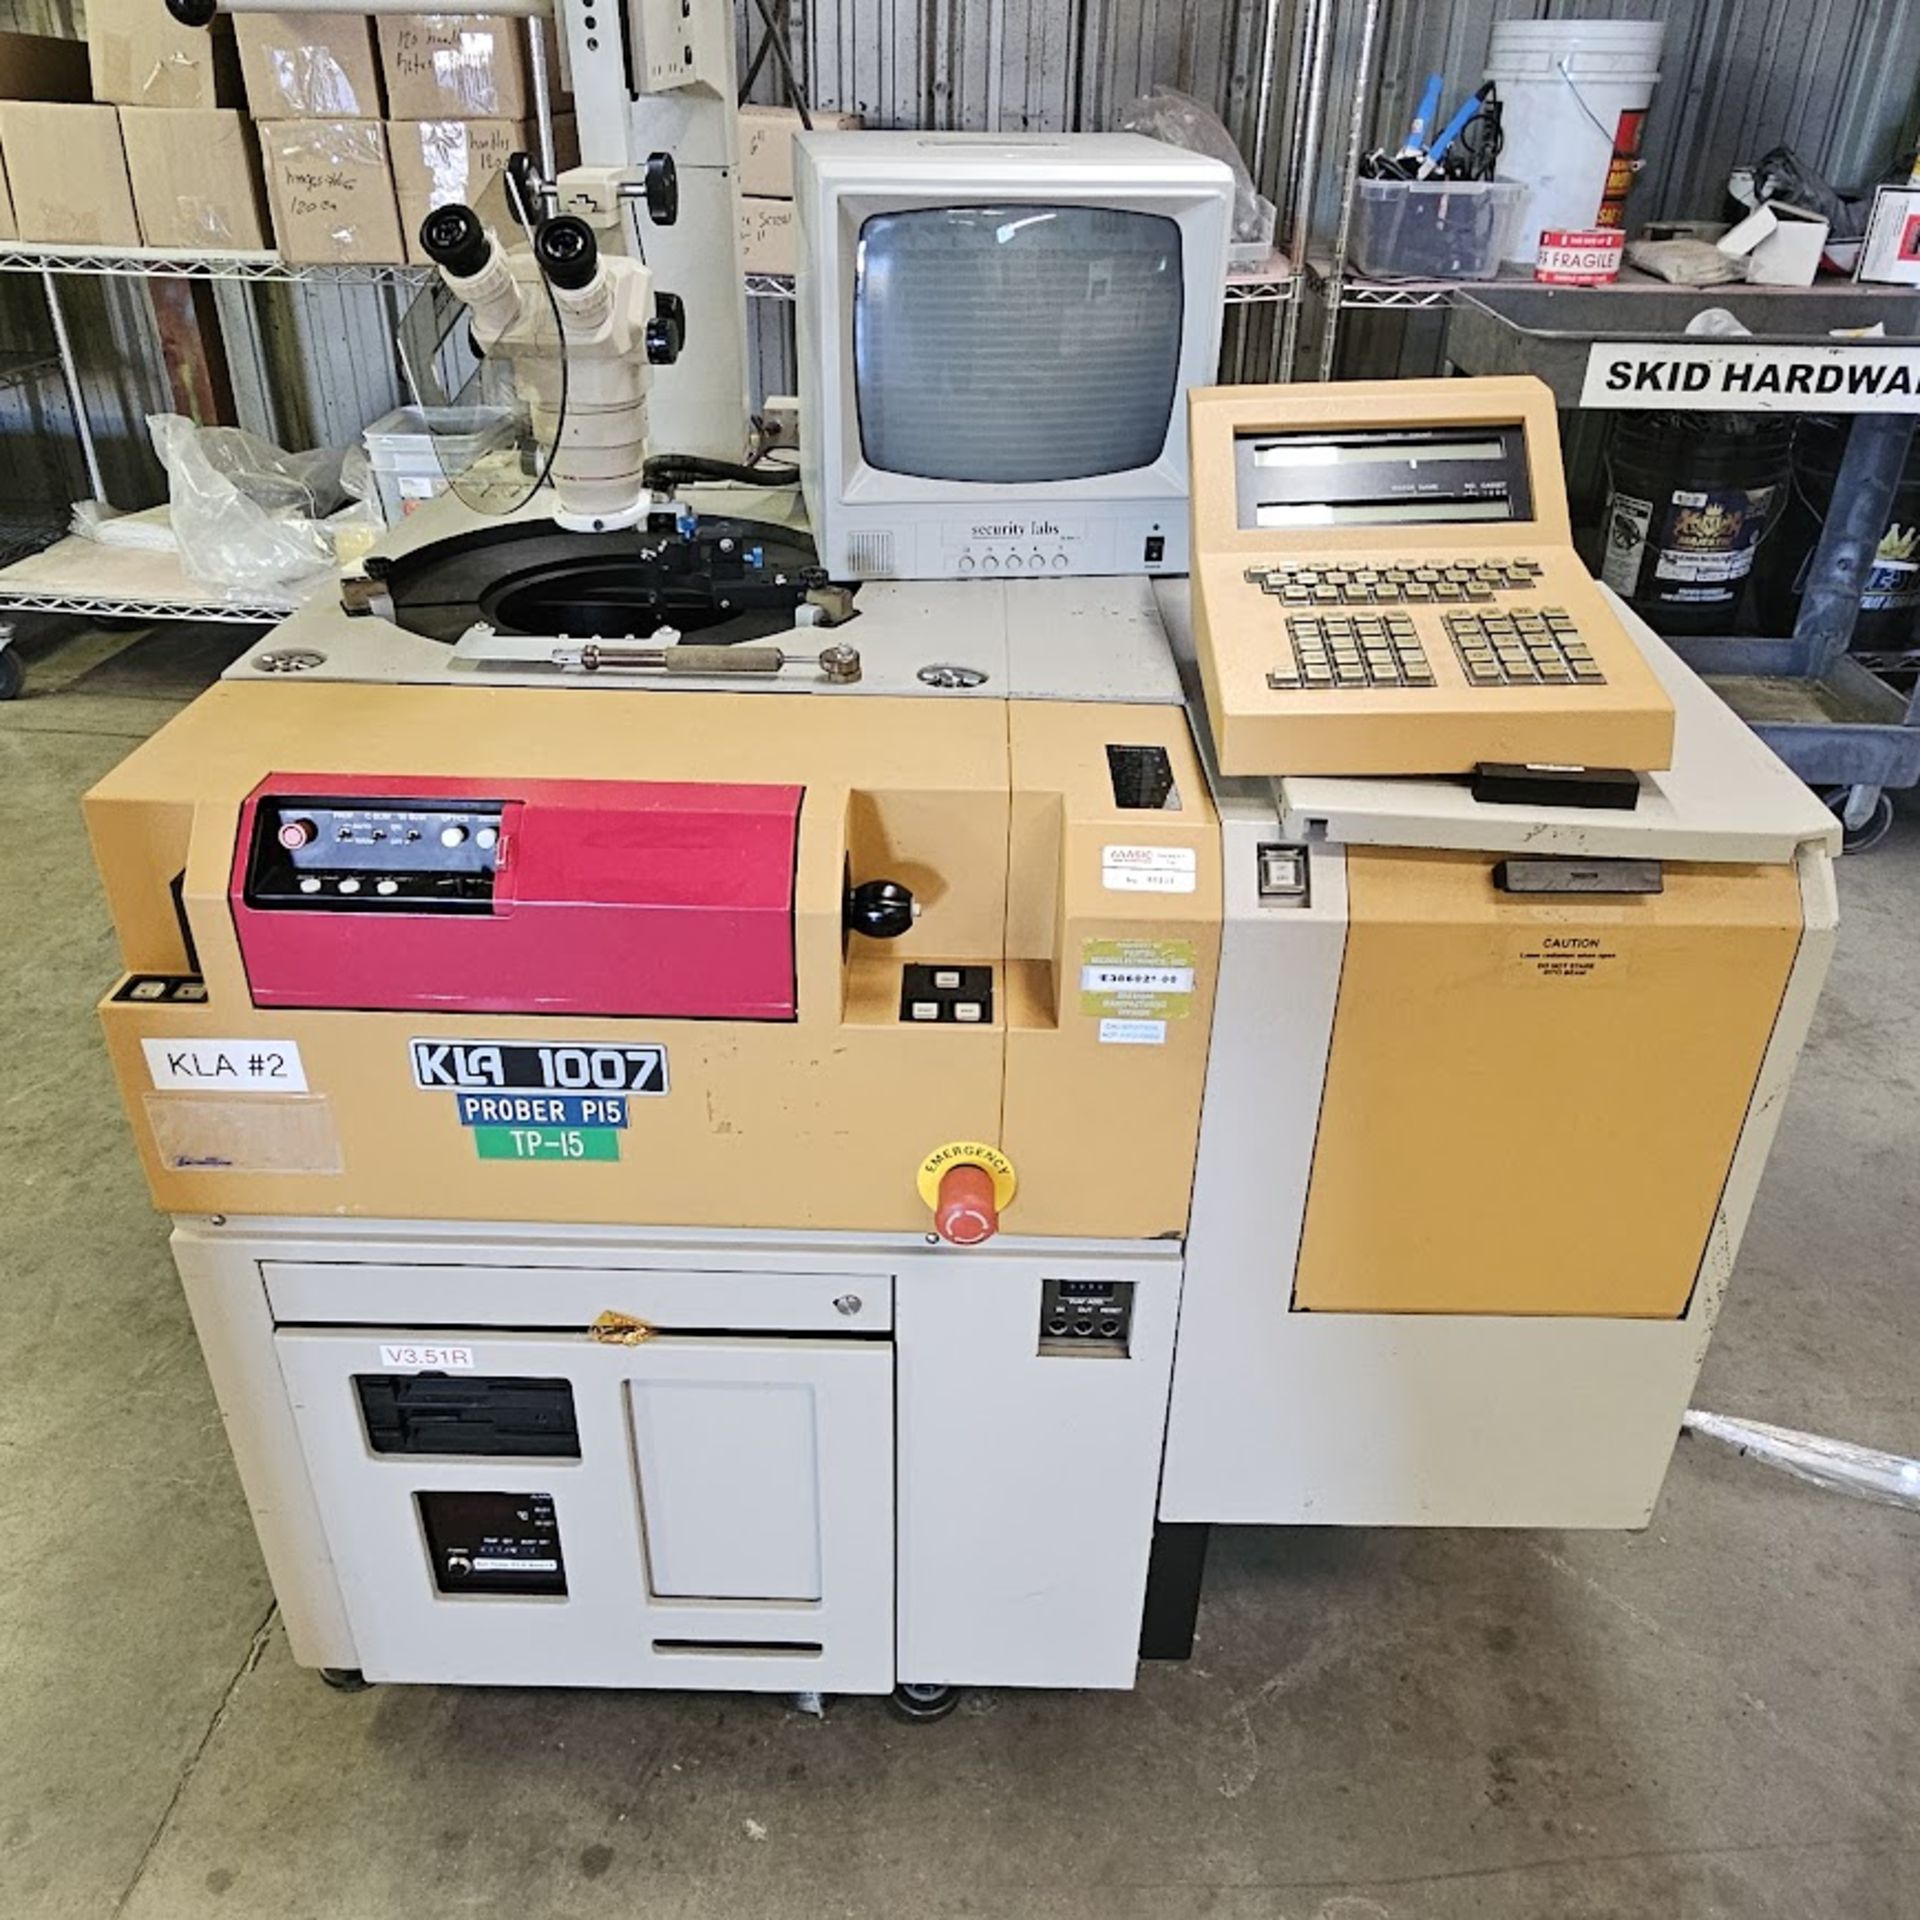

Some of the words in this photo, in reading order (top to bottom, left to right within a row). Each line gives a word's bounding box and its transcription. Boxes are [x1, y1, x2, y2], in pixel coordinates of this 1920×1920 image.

[1552, 250, 1615, 269] FRAGILE
[1606, 361, 1711, 391] SKID
[1721, 363, 1920, 395] HARDWA
[972, 521, 1025, 536] security
[1031, 521, 1060, 536] labs
[1543, 938, 1600, 949] CAUTION
[167, 1052, 238, 1077] KLA
[247, 1052, 288, 1077] #2
[416, 1045, 505, 1086] KLA
[538, 1048, 659, 1090] 1007
[465, 1098, 566, 1122] PROBER
[509, 1130, 584, 1157] TP-15
[925, 1145, 1011, 1175] EMERGENCY
[386, 1346, 469, 1364] V3.51R
